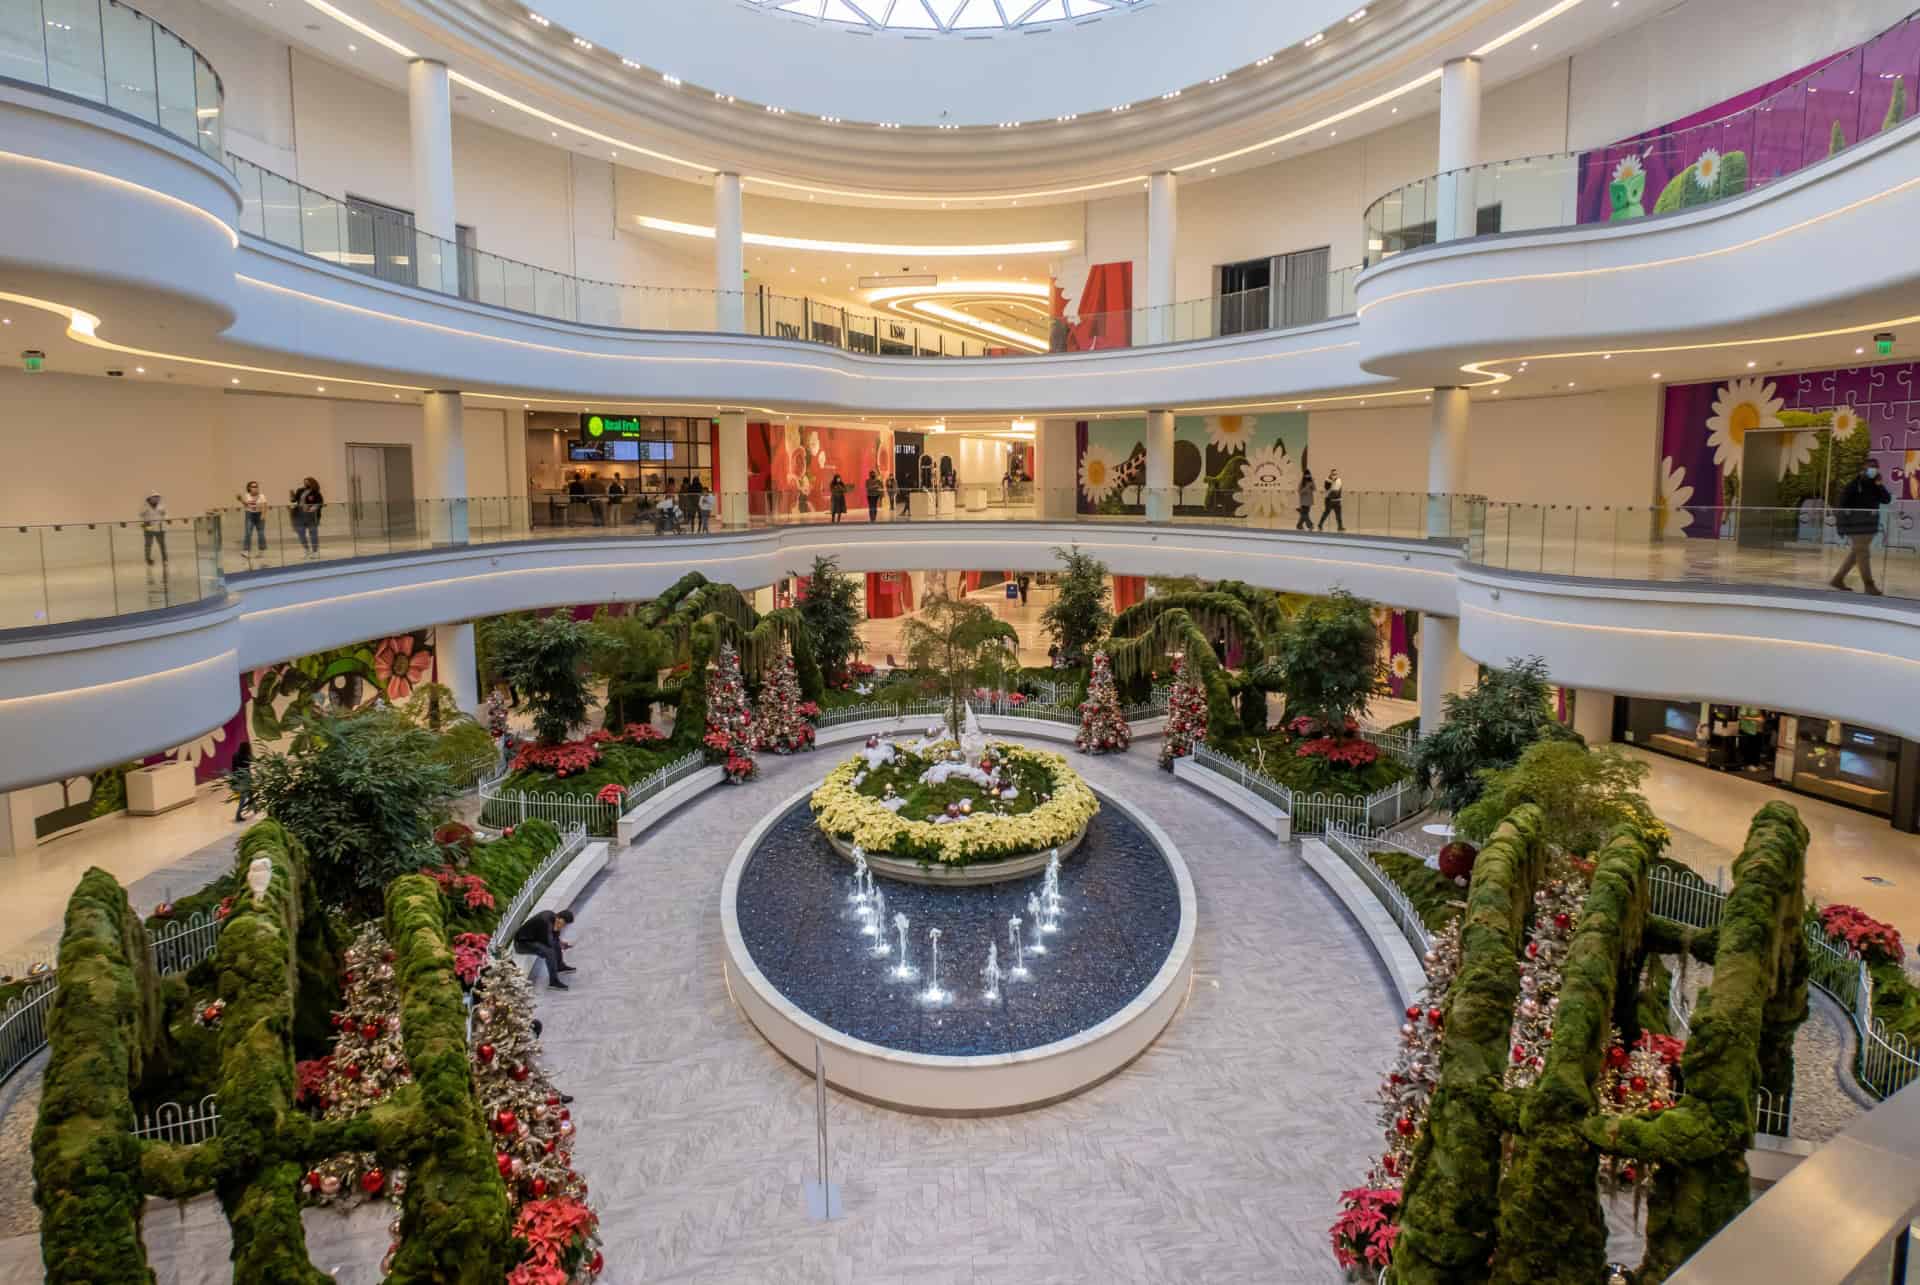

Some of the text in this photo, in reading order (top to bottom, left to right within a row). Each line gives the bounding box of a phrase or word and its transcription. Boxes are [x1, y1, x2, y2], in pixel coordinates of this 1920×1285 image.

[775, 321, 800, 340] DSW
[890, 323, 905, 340] DSW
[604, 418, 621, 431] Real
